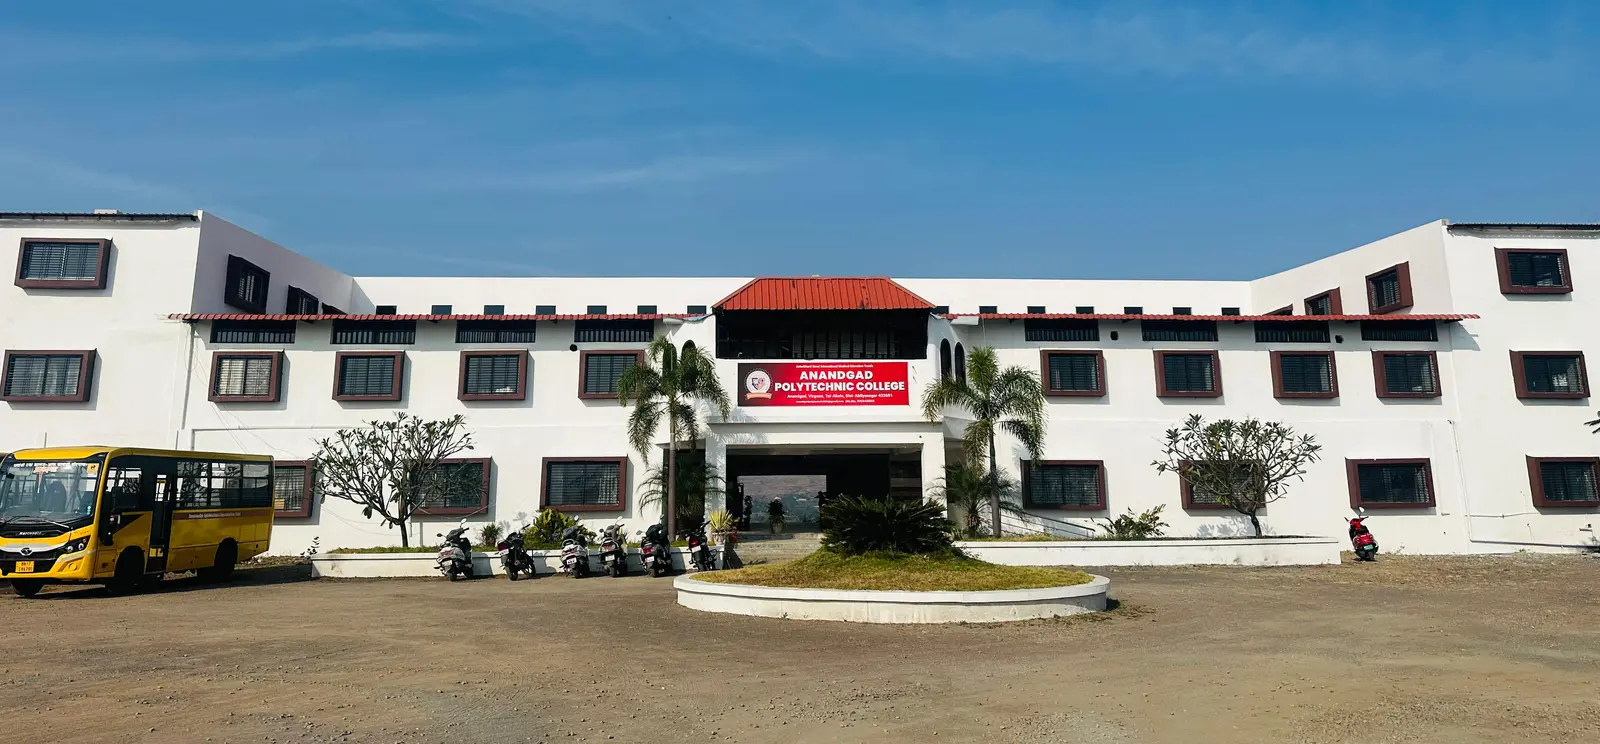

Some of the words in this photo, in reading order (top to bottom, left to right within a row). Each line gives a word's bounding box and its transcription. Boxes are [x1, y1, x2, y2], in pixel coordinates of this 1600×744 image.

[799, 370, 874, 380] ANANDGAD
[774, 381, 854, 392] POLYTECHNIC
[856, 381, 905, 391] COLLEGE
